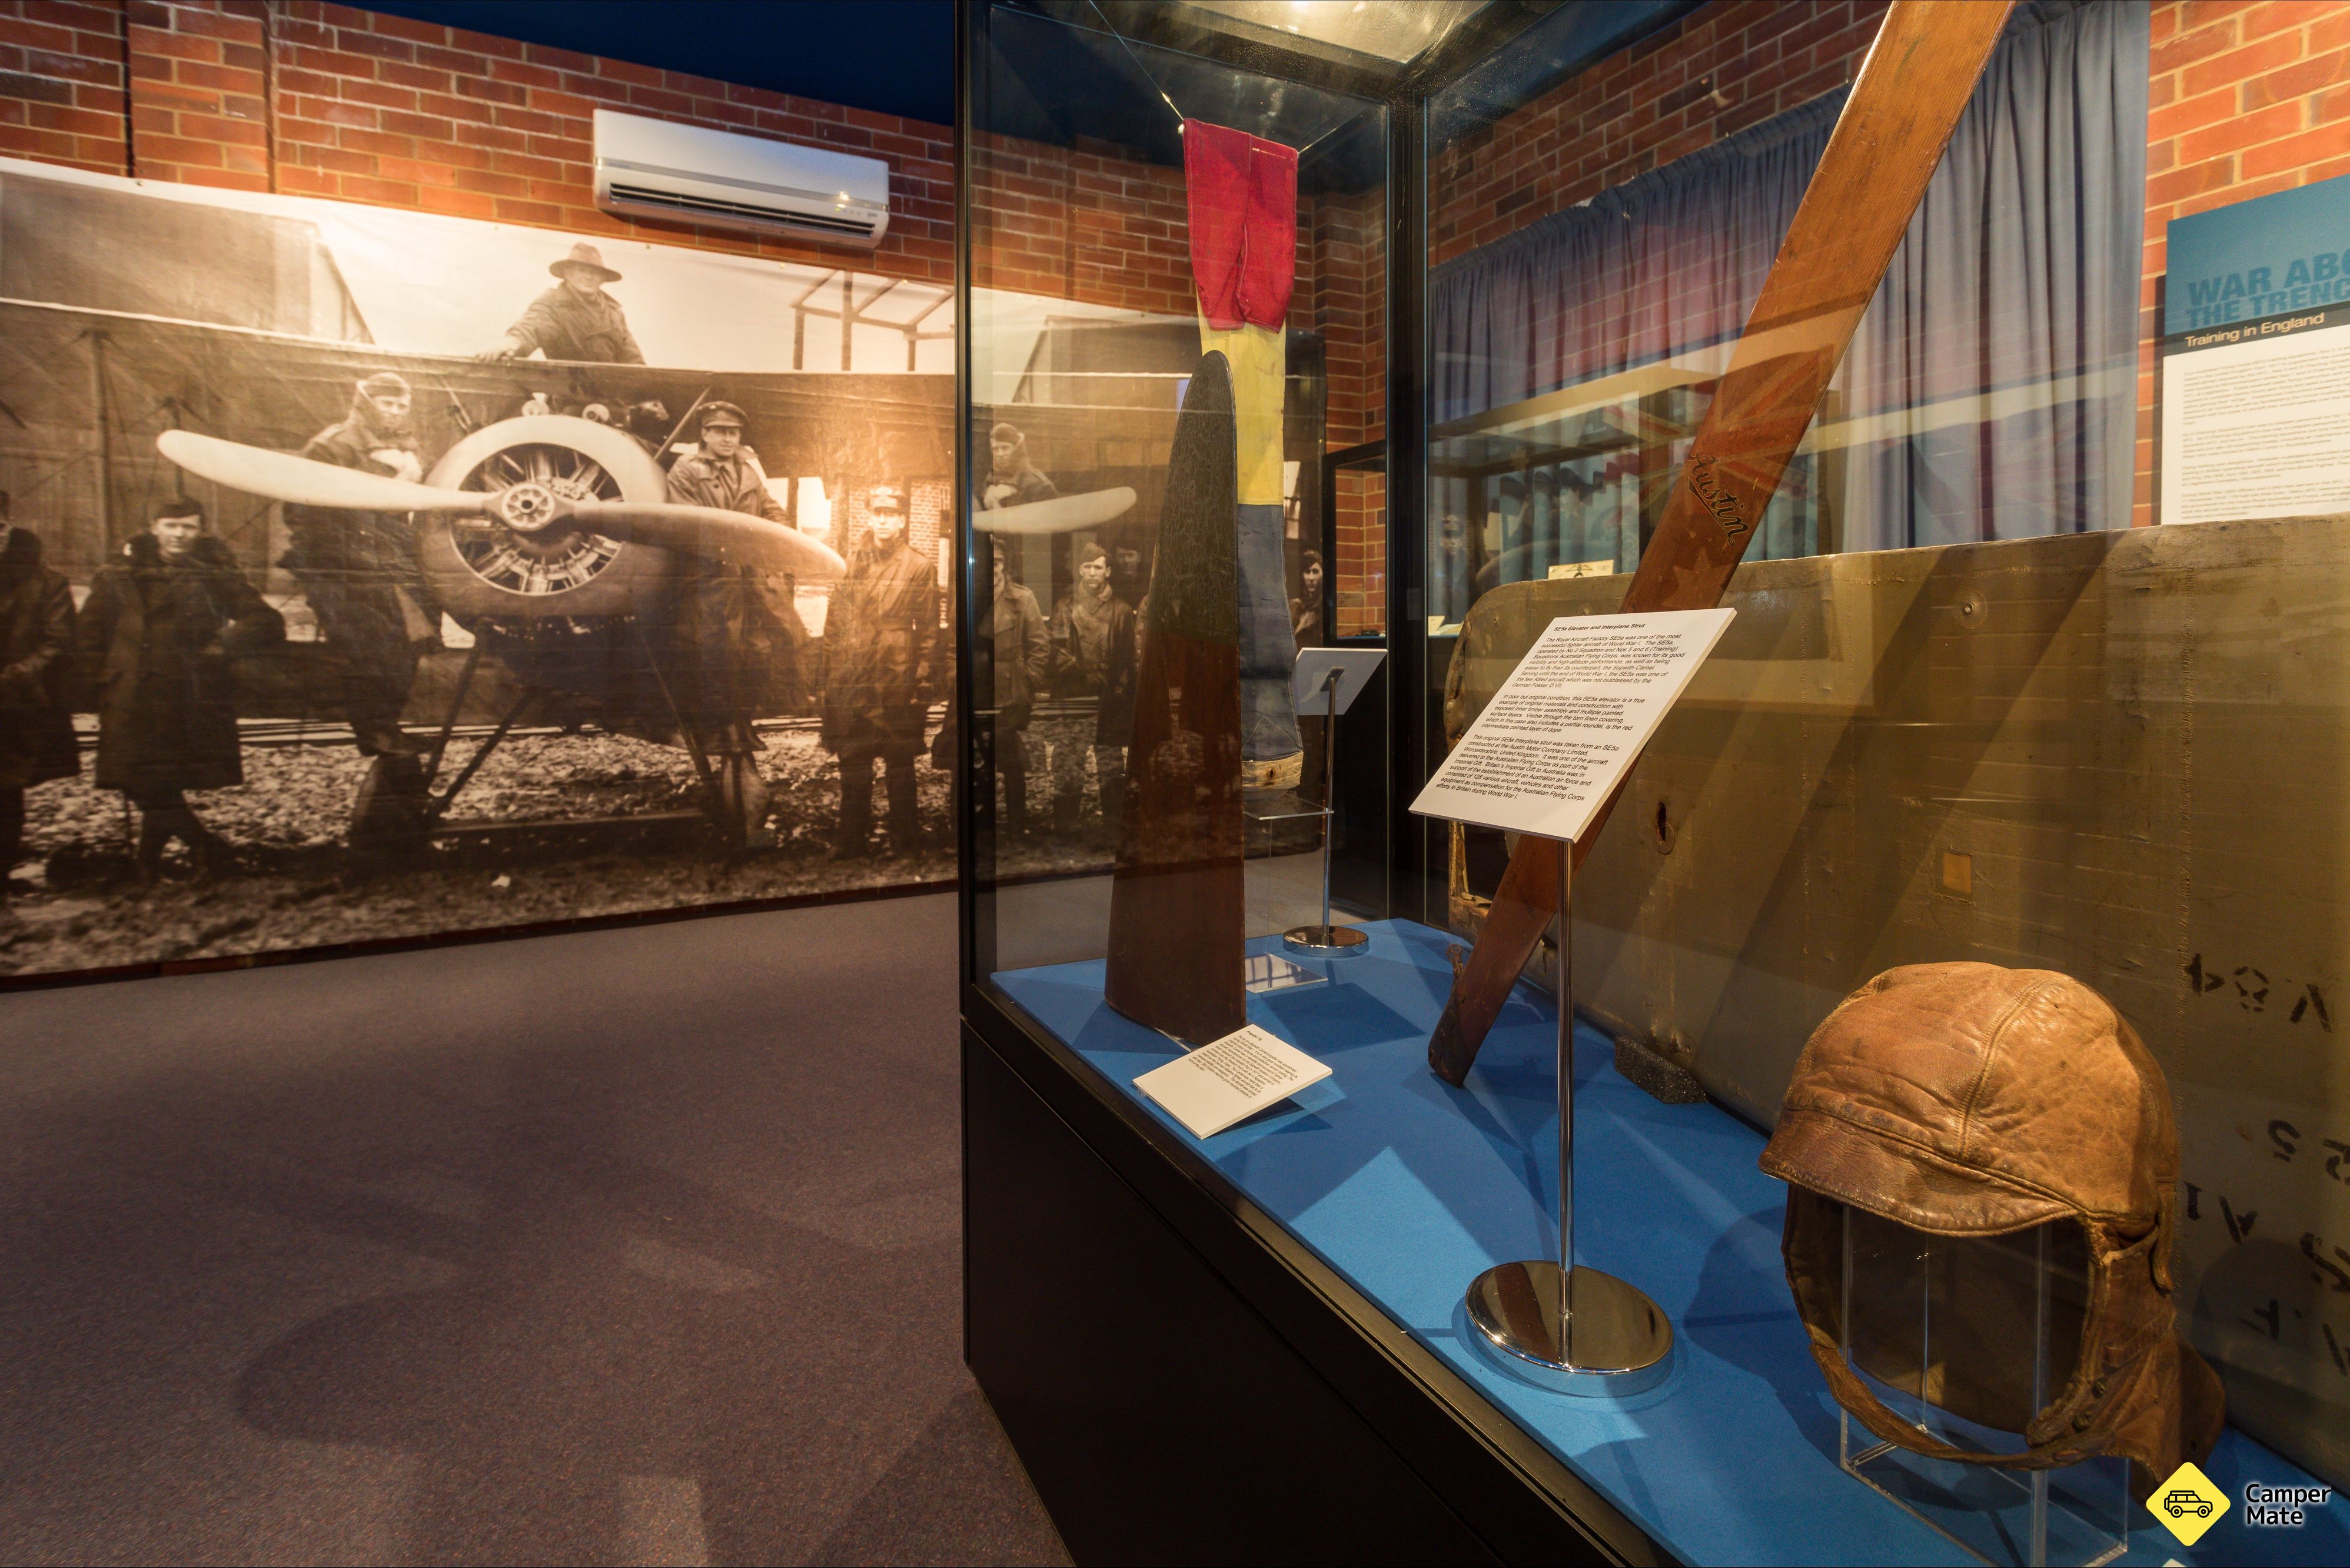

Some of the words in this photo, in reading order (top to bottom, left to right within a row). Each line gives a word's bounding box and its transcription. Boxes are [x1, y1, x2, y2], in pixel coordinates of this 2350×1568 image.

[2188, 266, 2271, 307] WAR
[2187, 300, 2241, 328] THE
[2185, 330, 2240, 347] Training
[2243, 326, 2257, 337] in
[2261, 312, 2325, 333] England
[1687, 451, 1749, 543] Austin
[1464, 746, 1498, 755] Worcestershire,
[1541, 746, 1567, 755] Company
[1528, 773, 1555, 782] Australian
[1471, 781, 1505, 789] compensation
[1521, 788, 1549, 796] Australian
[1549, 790, 1567, 799] Flying
